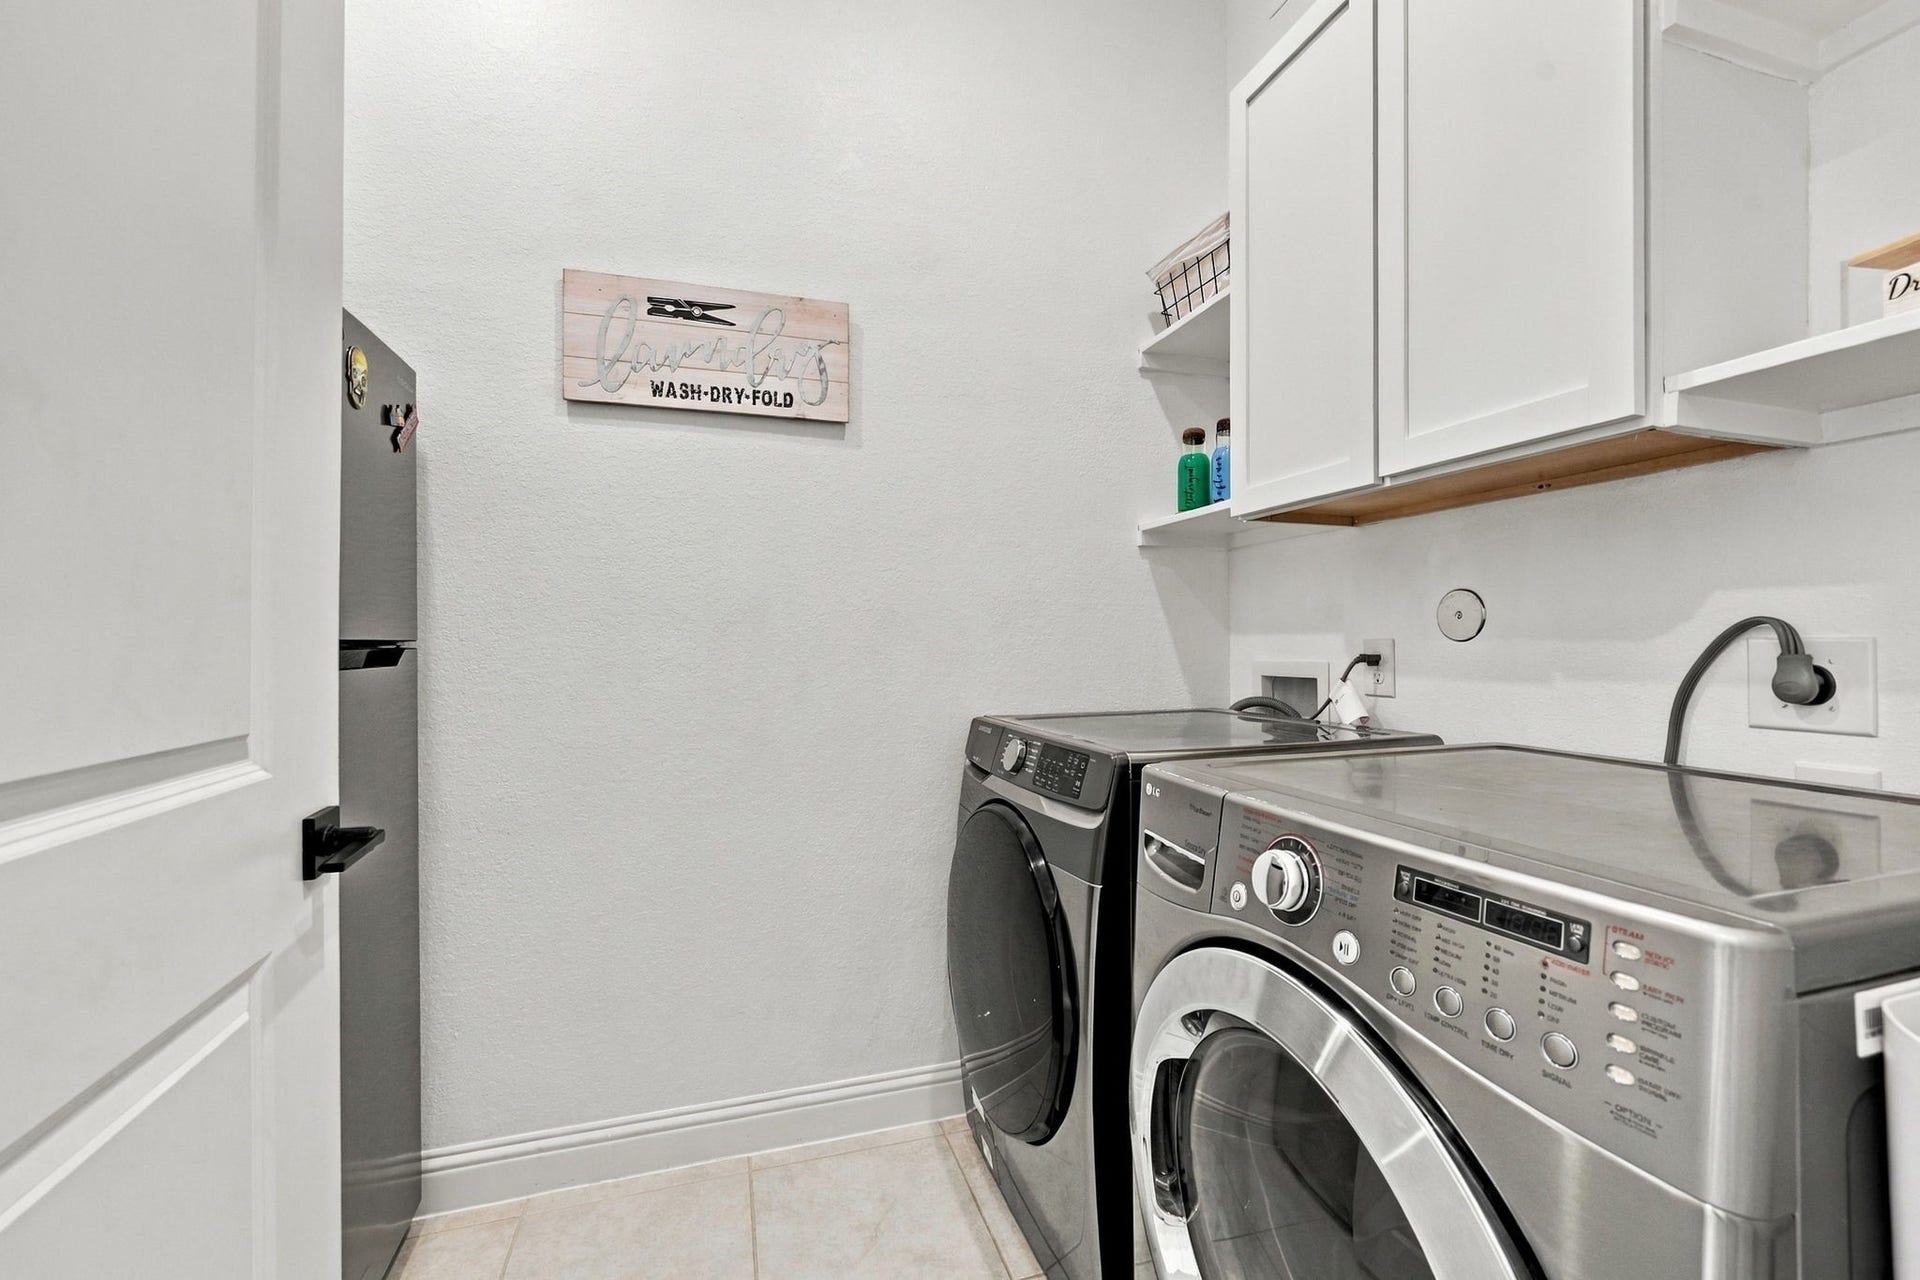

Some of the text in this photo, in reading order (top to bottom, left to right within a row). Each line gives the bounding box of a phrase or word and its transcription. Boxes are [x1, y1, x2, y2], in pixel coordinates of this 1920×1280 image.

[577, 295, 841, 407] laundry
[1611, 926, 1645, 941] STEAM
[1615, 1104, 1652, 1126] OPTION
